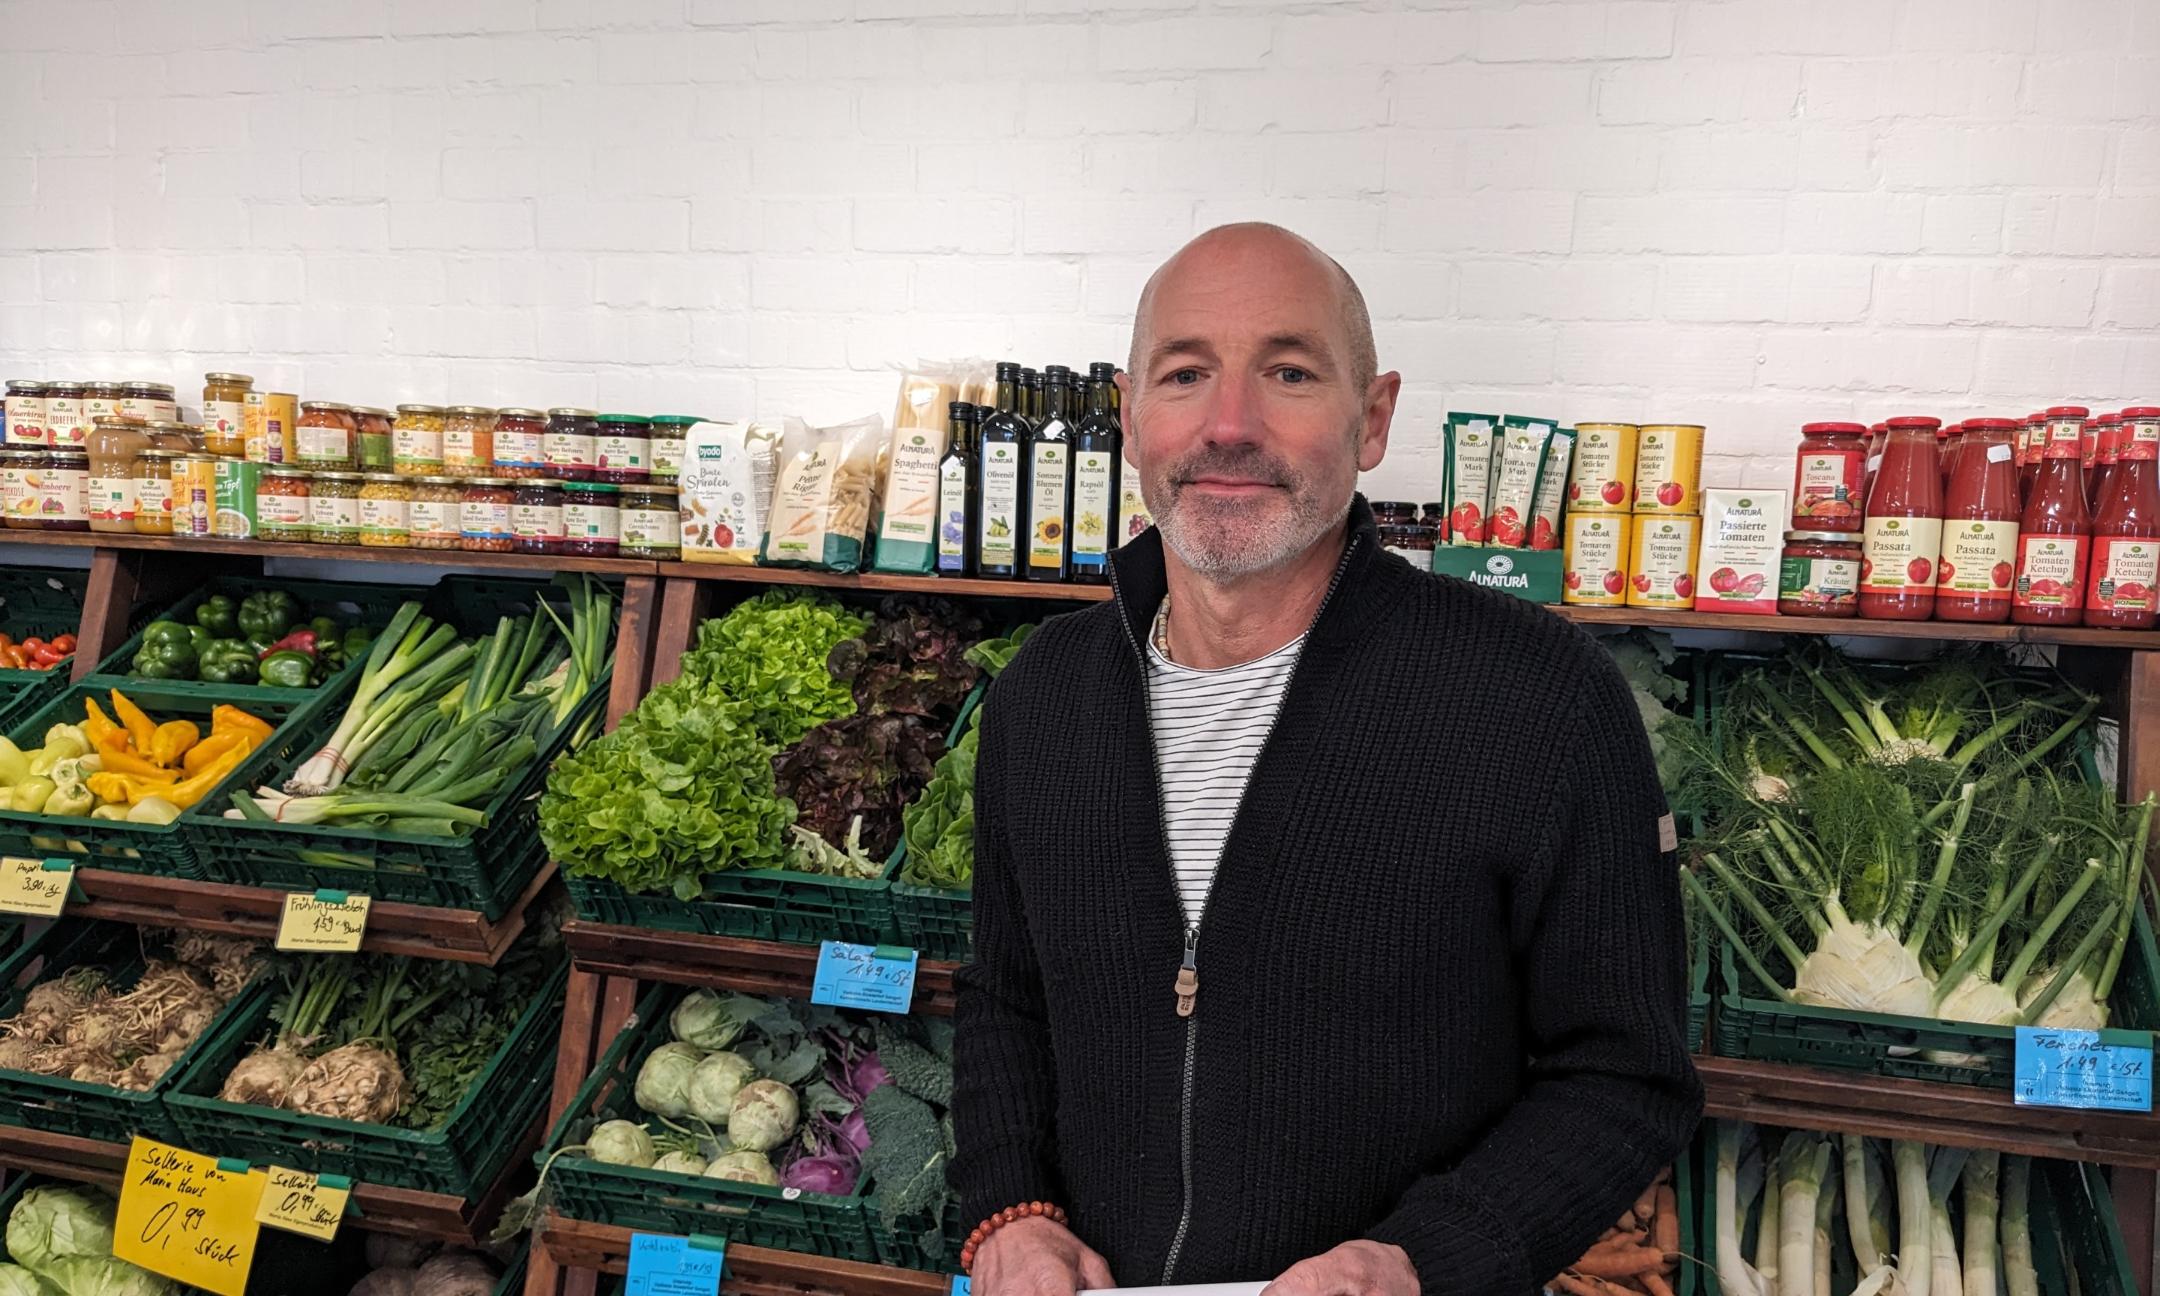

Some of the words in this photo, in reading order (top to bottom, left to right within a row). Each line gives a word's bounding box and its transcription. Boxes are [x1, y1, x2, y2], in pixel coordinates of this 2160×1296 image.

[700, 446, 721, 458] byodo
[900, 444, 936, 455] ALNATURA
[1458, 454, 1489, 463] Tomaten
[1580, 452, 1610, 460] Tomaten
[894, 458, 938, 470] Spaghetti
[1464, 463, 1484, 472] Mark
[1582, 460, 1606, 468] Stücke
[1640, 462, 1661, 470] Stücke
[700, 467, 722, 478] Bunte
[1544, 470, 1564, 478] maten
[686, 474, 730, 490] Spiralen
[1036, 480, 1062, 488] Blumen
[1080, 481, 1104, 490] Rapsöl
[1726, 508, 1762, 516] ALNATURA
[1720, 520, 1767, 530] Passierte
[1720, 532, 1765, 542] Tomaten
[1876, 529, 1910, 537] ALNATURA
[1960, 532, 1995, 540] ALNATURA
[1579, 541, 1611, 550] Tomaten
[1649, 544, 1682, 552] Tomaten
[1873, 541, 1911, 552] Passata
[1956, 544, 1996, 556] Passata
[1582, 549, 1607, 558] Stücke
[1652, 552, 1678, 560] Stücke
[2030, 556, 2070, 565] Tomaten
[2114, 558, 2154, 568] Tomaten
[2030, 564, 2069, 575] Ketchup
[2114, 568, 2153, 578] Ketchup
[1468, 570, 1528, 588] ALNATURA
[1824, 576, 1850, 585] Kräuter
[831, 946, 876, 962] Salat
[2032, 1034, 2112, 1053] Fenchel
[142, 1147, 194, 1174] Sellerie
[204, 1168, 228, 1183] von
[140, 1168, 172, 1188] Maria
[178, 1176, 207, 1198] Haus
[281, 1192, 315, 1214] 0,99
[141, 1201, 206, 1250] 0,99
[194, 1236, 241, 1268] Stück
